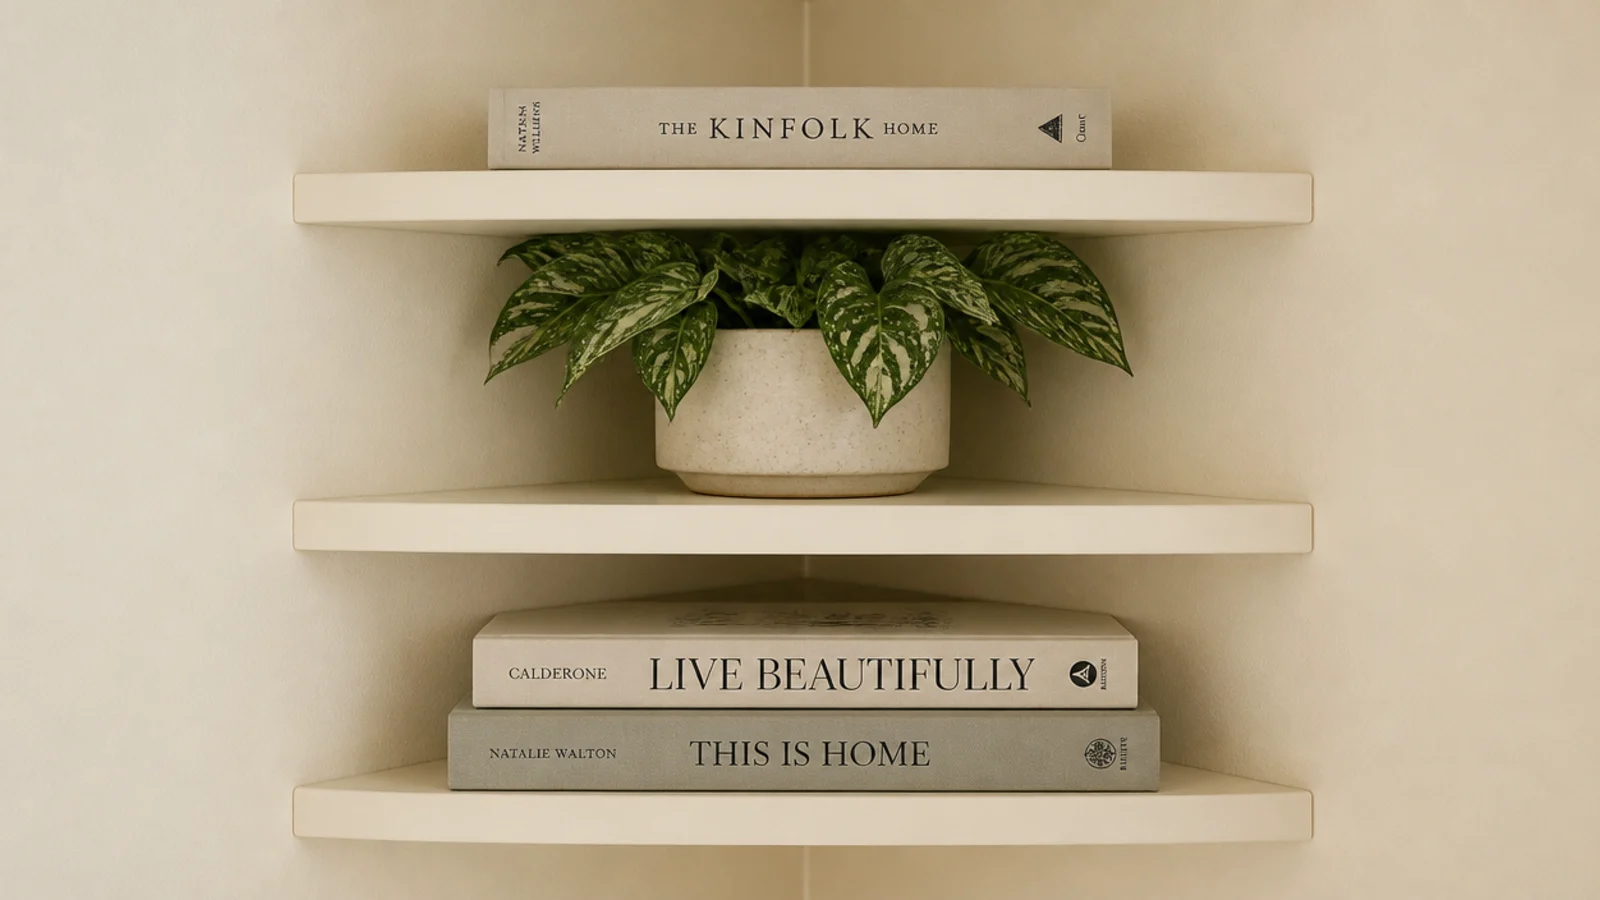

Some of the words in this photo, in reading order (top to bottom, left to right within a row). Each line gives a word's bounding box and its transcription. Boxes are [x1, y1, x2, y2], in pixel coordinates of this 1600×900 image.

[658, 122, 698, 135] THE
[708, 116, 875, 140] KINFOLK
[883, 122, 939, 135] HOME
[508, 666, 608, 681] CALDERONE
[650, 657, 744, 691] LIVE
[757, 657, 1036, 692] BEAUTIFULLY
[489, 748, 551, 760] NATALIE
[554, 748, 617, 760] WALTON
[689, 740, 770, 767] THIS
[781, 740, 810, 767] IS
[821, 740, 931, 767] HOME
